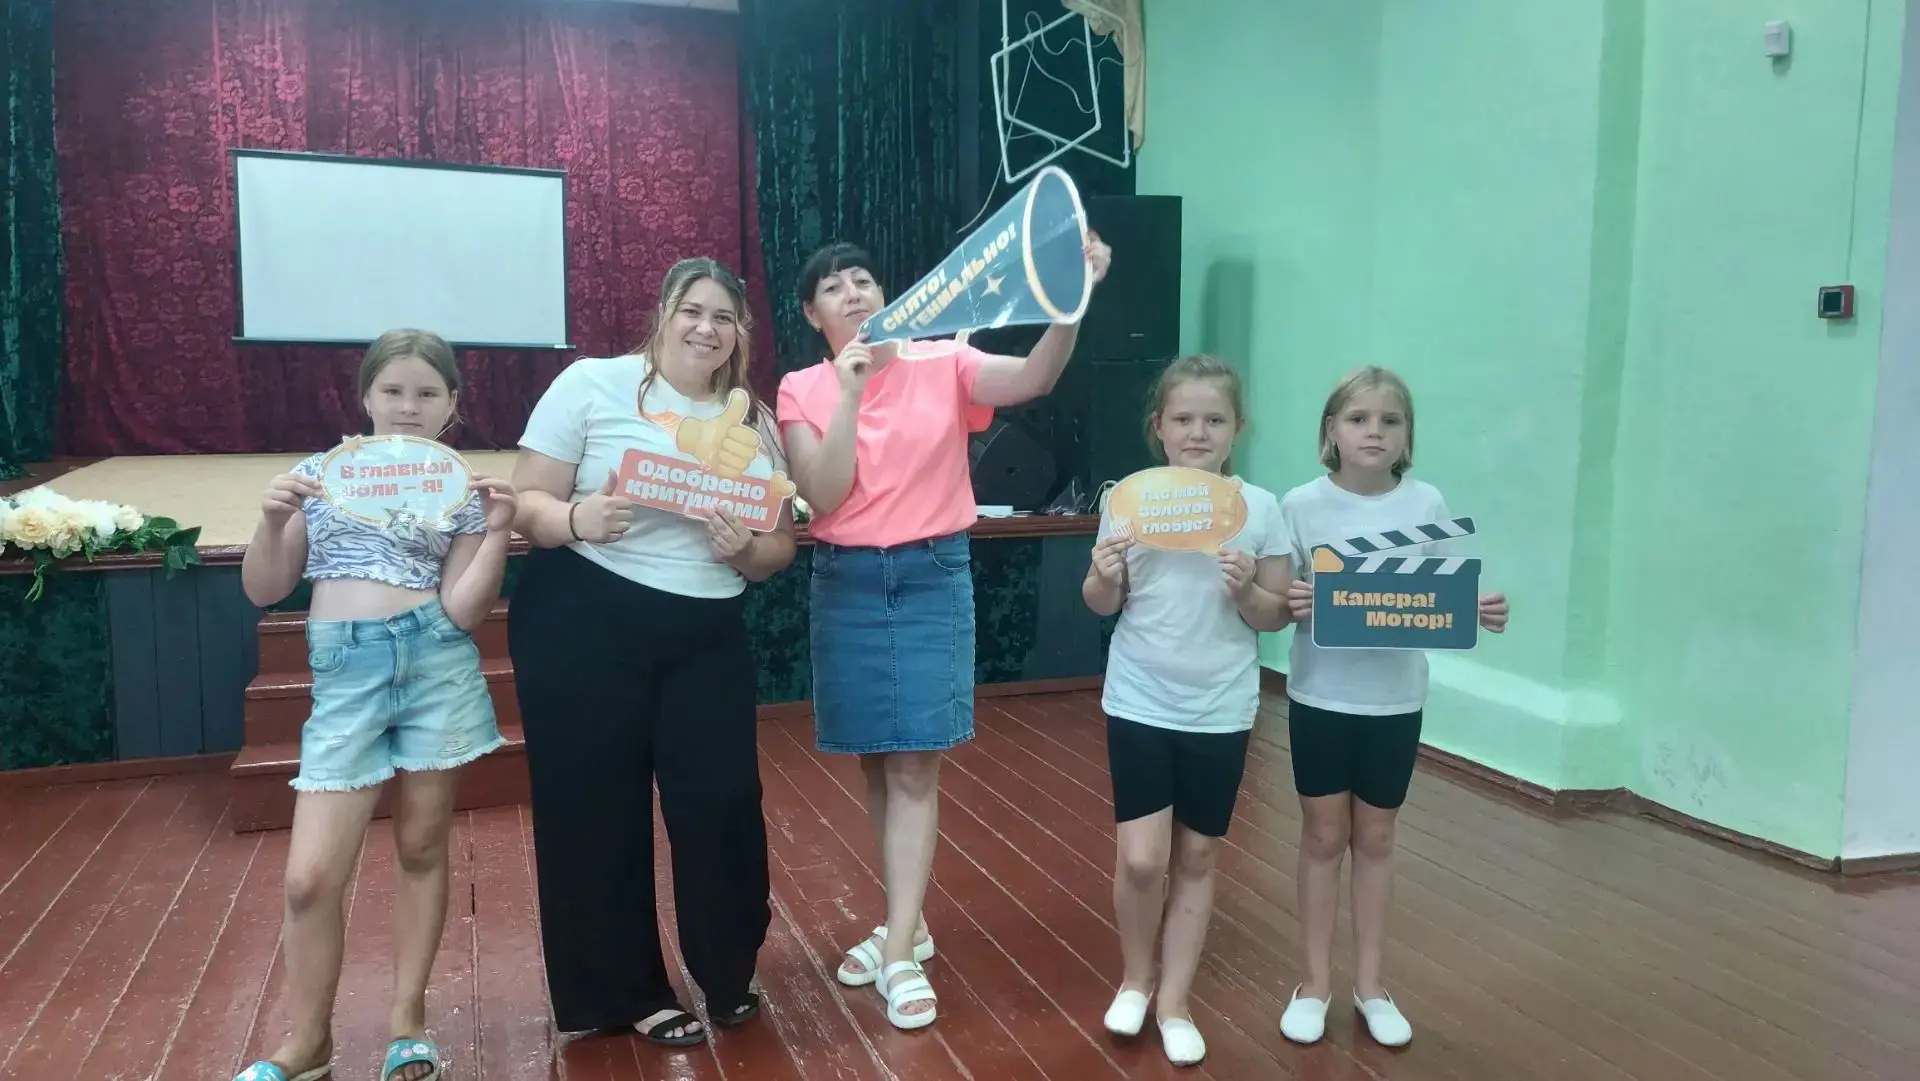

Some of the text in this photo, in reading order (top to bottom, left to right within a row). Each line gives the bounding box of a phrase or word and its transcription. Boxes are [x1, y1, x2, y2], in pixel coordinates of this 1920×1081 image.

[883, 269, 947, 331] СНЯТО!
[340, 457, 453, 479] В главной
[422, 479, 444, 494] Я!
[637, 459, 766, 500] Одобрено
[1177, 483, 1209, 498] мой
[1138, 499, 1213, 517] золотой
[1143, 518, 1213, 534] глобус?
[1332, 590, 1436, 609] Камера!
[1366, 611, 1453, 630] Мотор!
